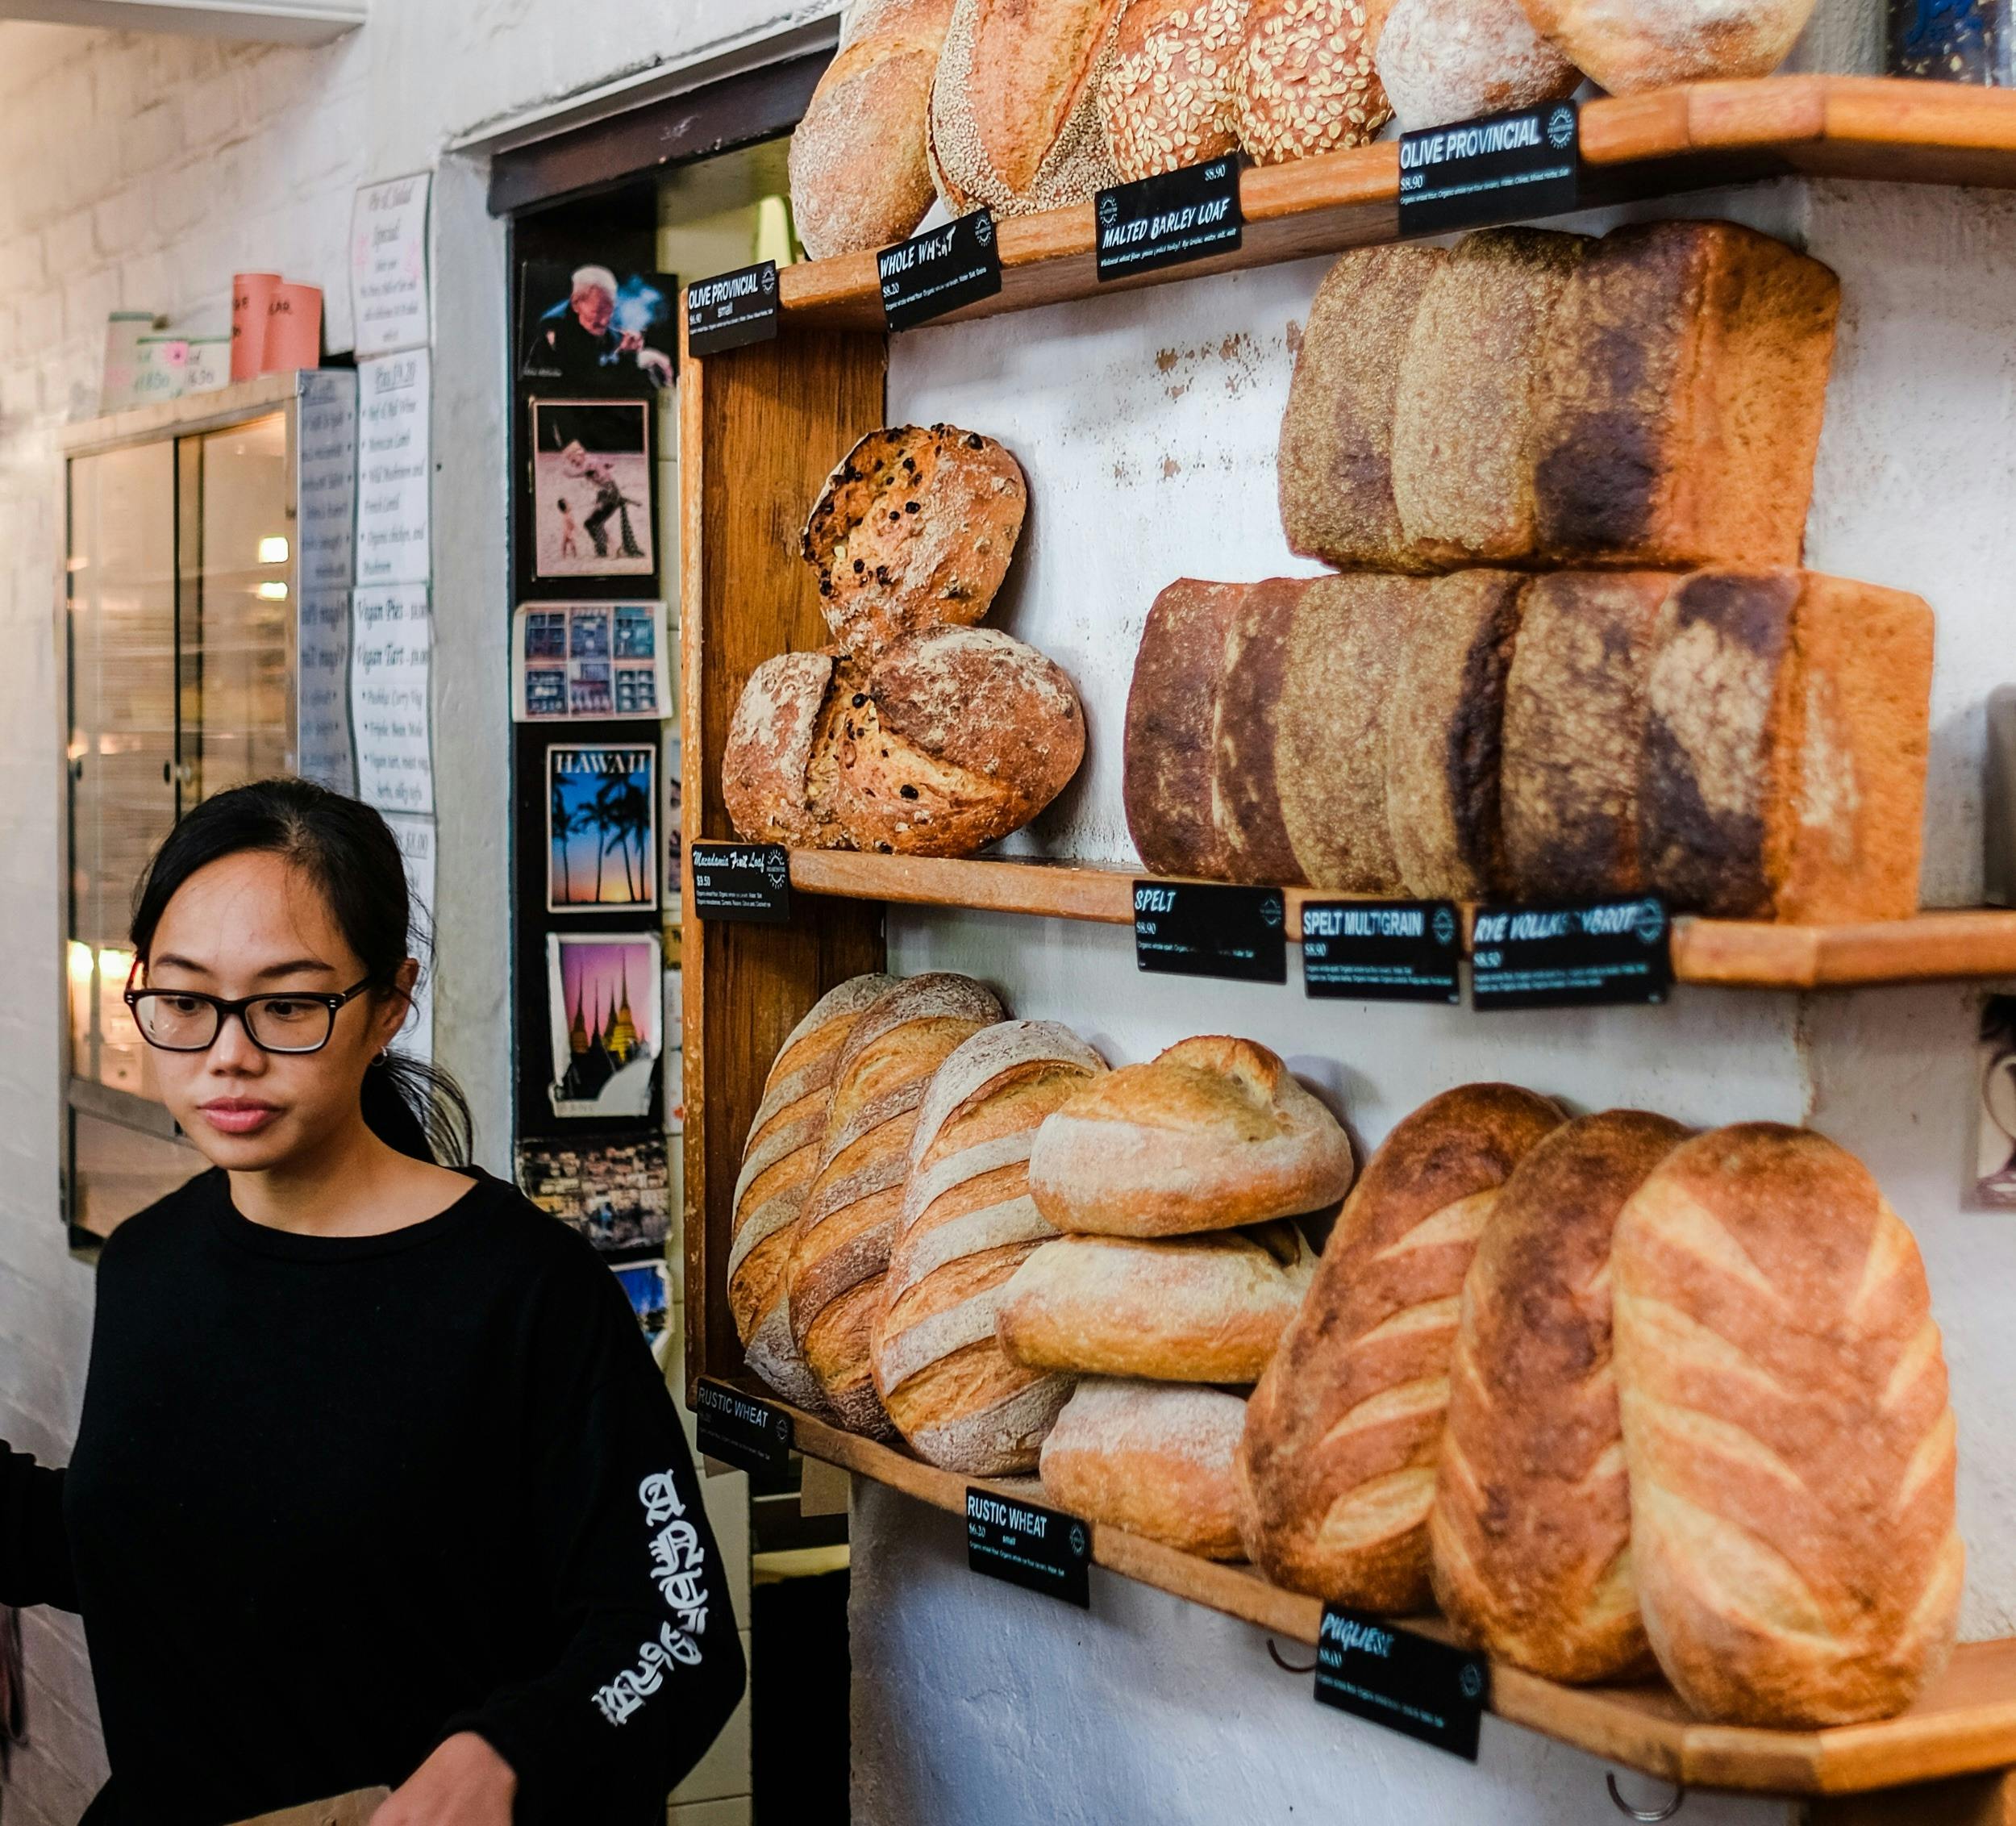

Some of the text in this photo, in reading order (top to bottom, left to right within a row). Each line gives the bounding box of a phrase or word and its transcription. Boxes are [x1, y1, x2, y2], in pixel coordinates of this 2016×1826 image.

[1400, 117, 1541, 170] OLIVE PROVINCIAL
[1102, 219, 1148, 249] MALTED
[1151, 207, 1196, 240] BARLEY
[1198, 197, 1231, 226] LOAF
[880, 244, 915, 280] WHOLE
[689, 273, 758, 310] OLIVE PROVINCIAL
[357, 599, 383, 631] Vegan
[356, 642, 381, 674] Vegan
[556, 752, 646, 773] HAWAII
[1135, 889, 1177, 913] SPELT
[1303, 911, 1343, 936] SPELT
[698, 1387, 768, 1428] RUSTIC WHEAT
[968, 1495, 1048, 1539] RUSTIC WHEAT
